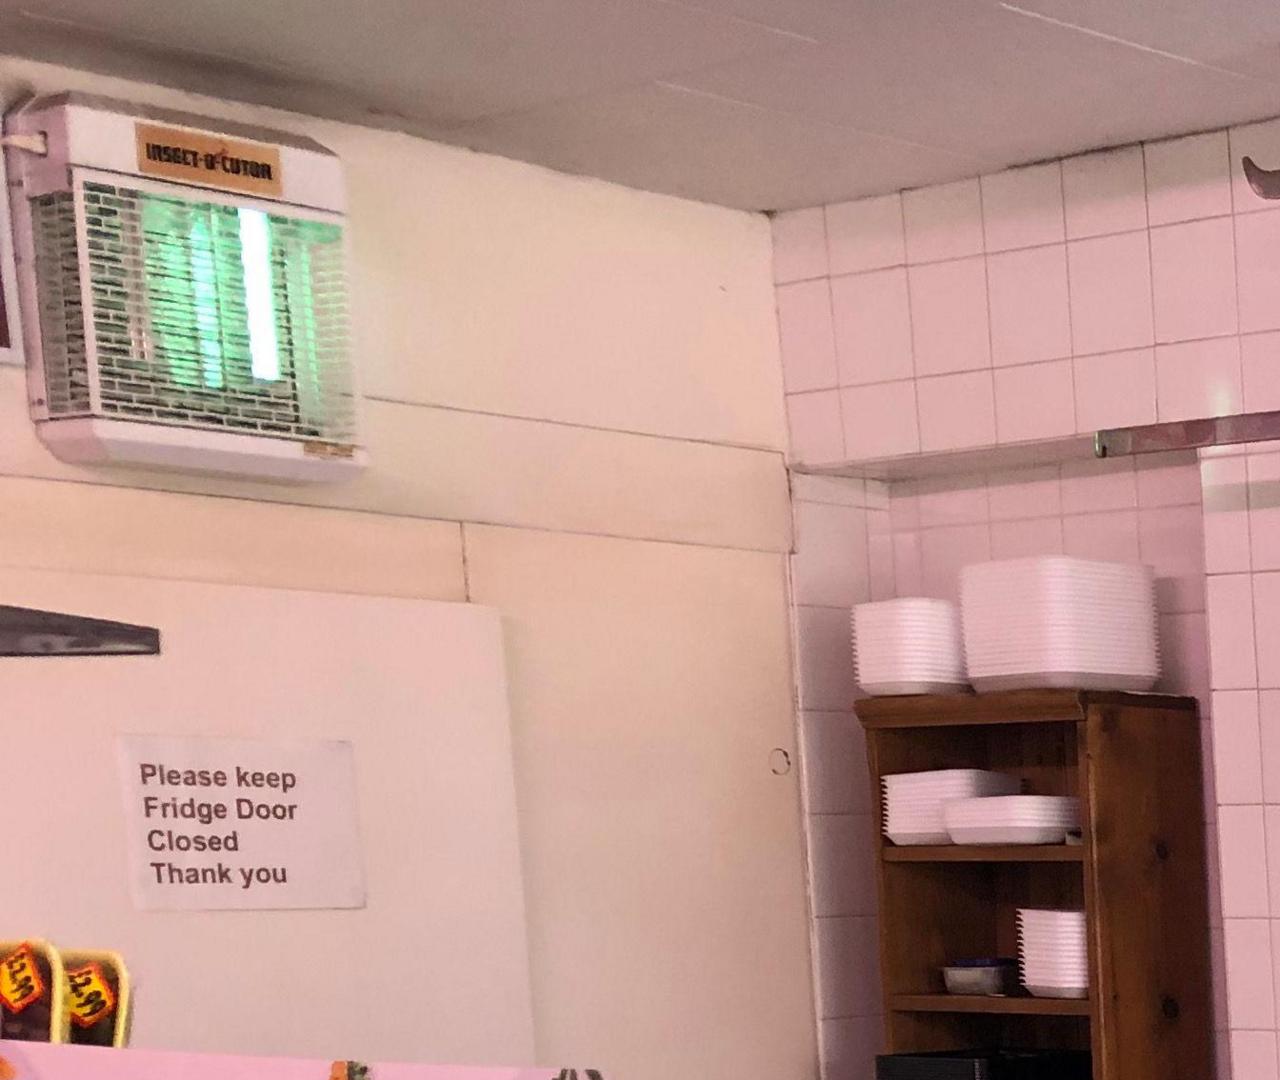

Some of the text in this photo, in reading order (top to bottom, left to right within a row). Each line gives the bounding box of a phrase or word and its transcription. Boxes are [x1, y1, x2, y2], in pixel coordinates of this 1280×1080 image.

[139, 763, 296, 792] Please keep
[143, 796, 297, 824] Fridge Door
[147, 829, 239, 851] Closed
[150, 862, 287, 889] Thank you
